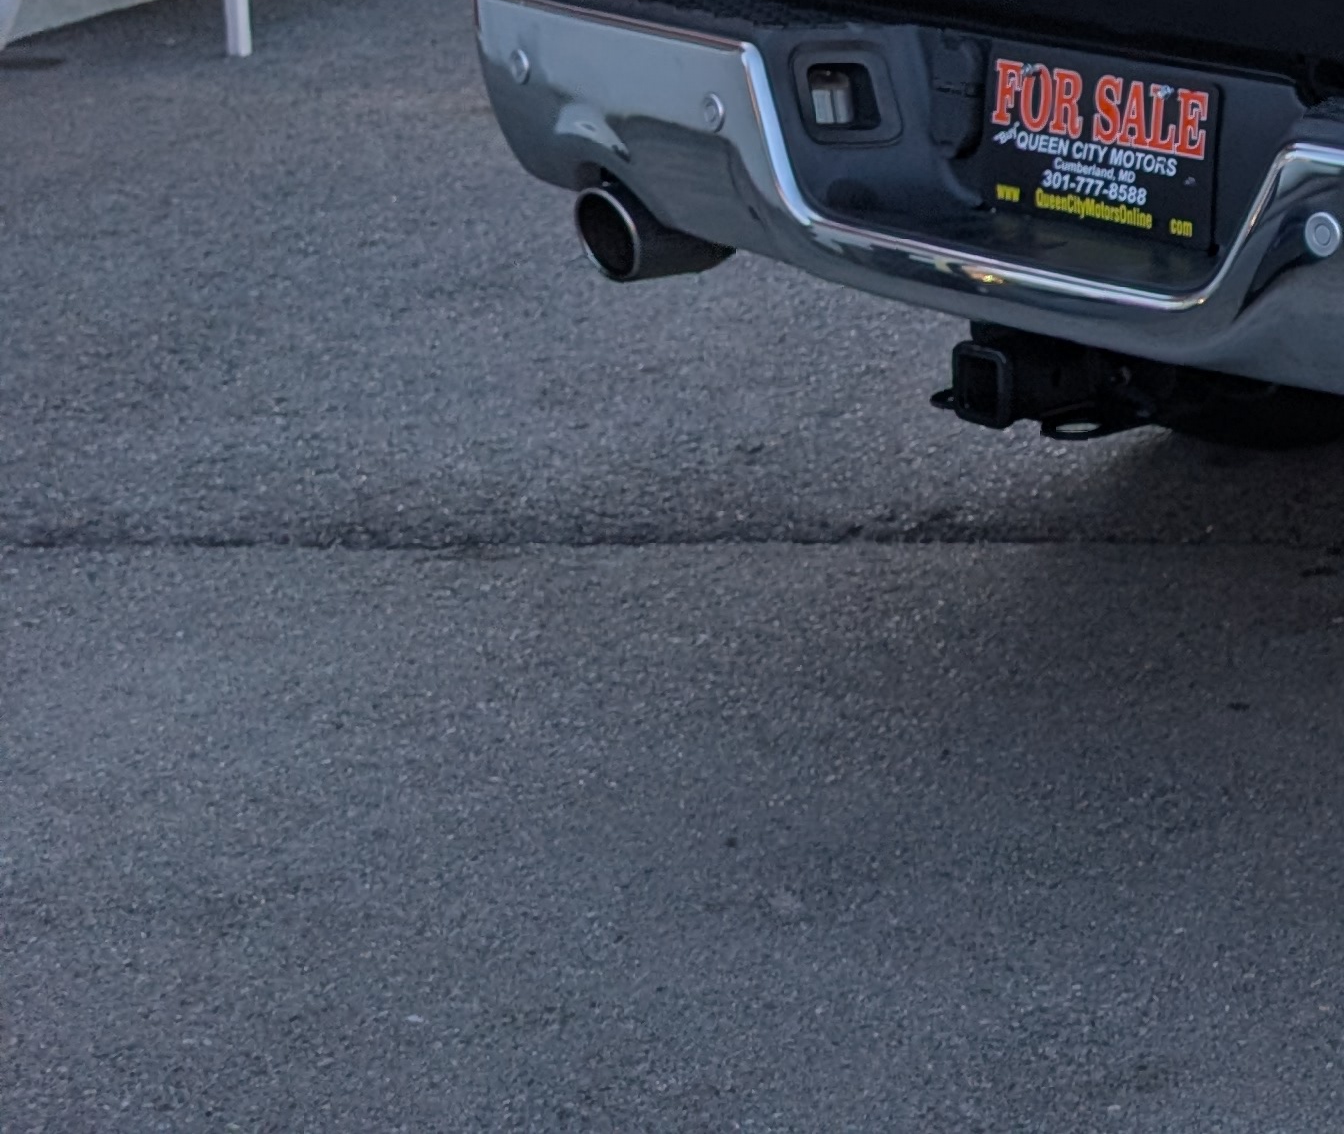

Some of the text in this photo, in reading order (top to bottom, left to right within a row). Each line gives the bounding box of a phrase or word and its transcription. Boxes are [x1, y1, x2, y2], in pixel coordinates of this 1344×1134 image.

[991, 59, 1209, 160] FOR SALE
[1016, 131, 1178, 177] QUEEN CITY MOTORS
[1054, 157, 1136, 184] Cumberland, MD
[1041, 169, 1148, 206] 301-777-8588
[1035, 188, 1152, 229] QueenCityMotorsOnline
[1169, 218, 1193, 237] com
